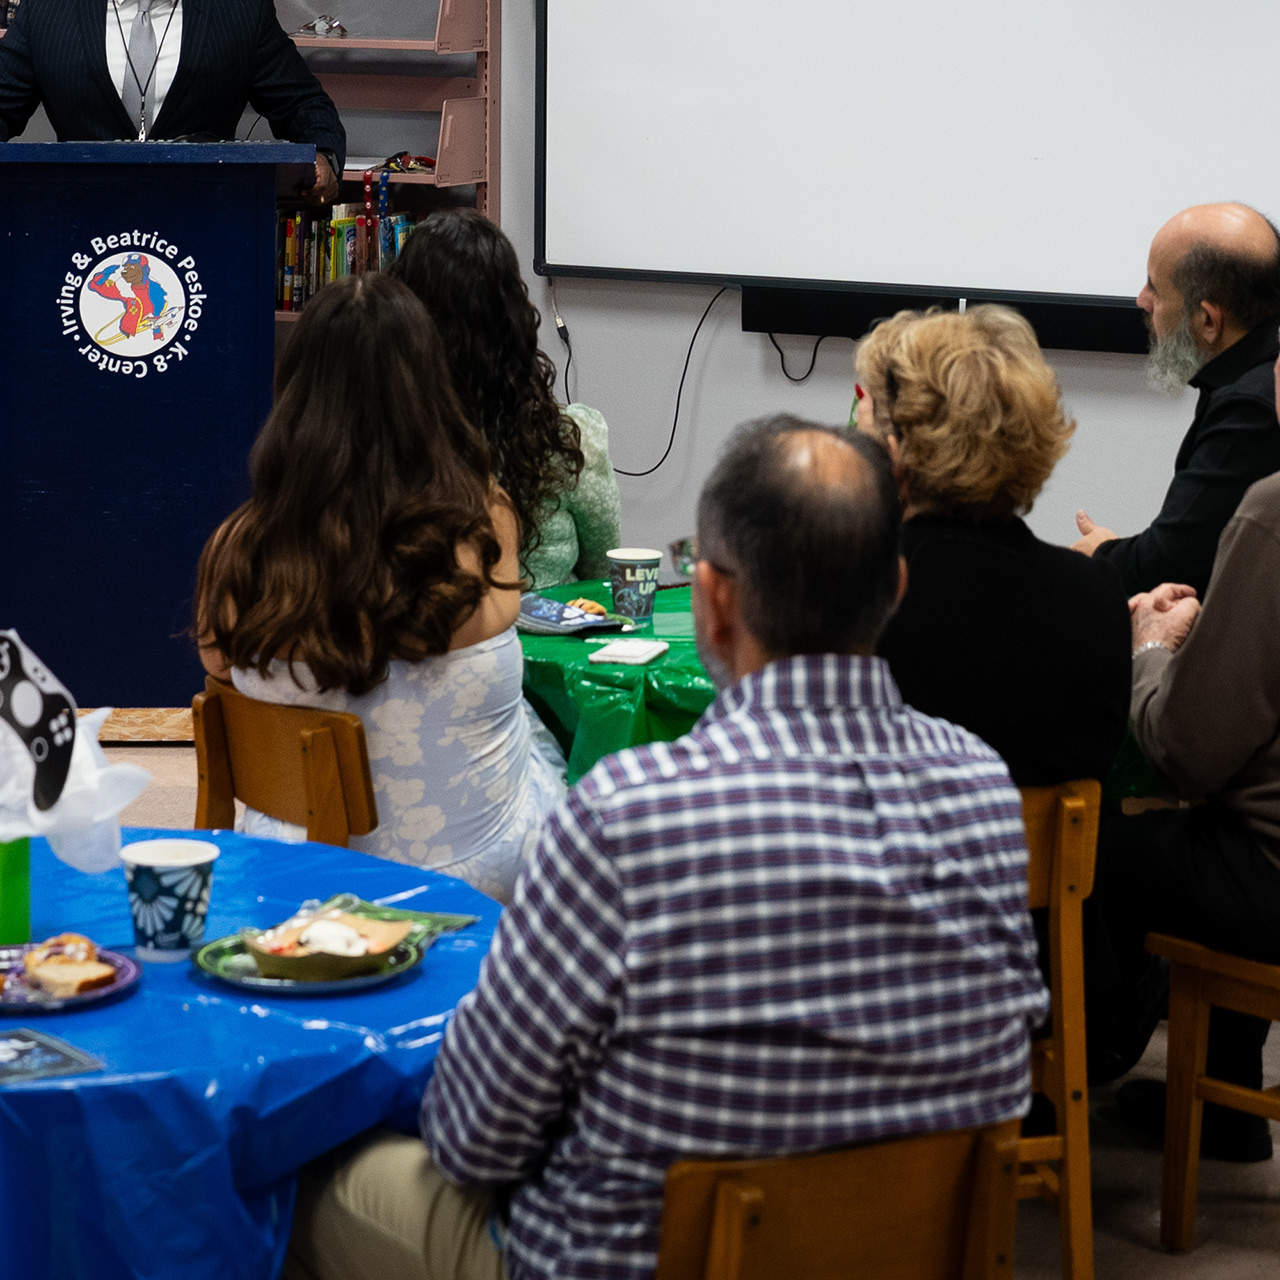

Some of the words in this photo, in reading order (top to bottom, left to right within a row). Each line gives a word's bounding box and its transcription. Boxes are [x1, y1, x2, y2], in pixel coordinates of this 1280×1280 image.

[90, 229, 178, 259] Beatrice
[72, 252, 93, 270] &
[56, 272, 83, 335] Irving
[177, 256, 207, 331] Peskoe
[78, 344, 148, 378] Center
[153, 342, 189, 372] K-8
[625, 568, 659, 581] LEVE
[639, 581, 656, 595] UP
